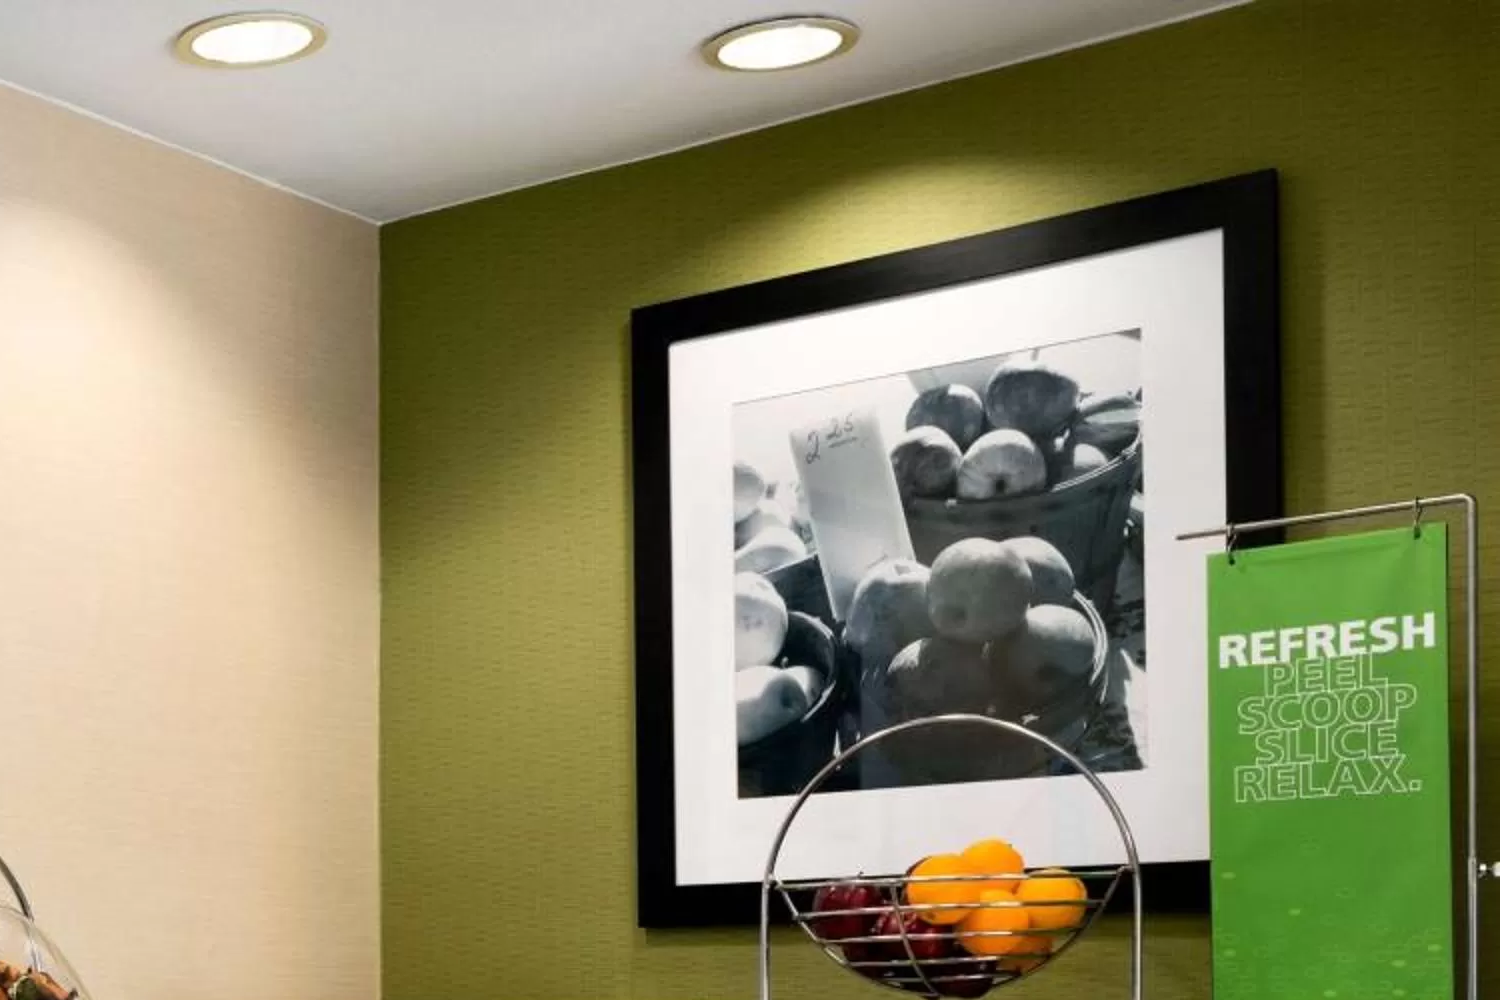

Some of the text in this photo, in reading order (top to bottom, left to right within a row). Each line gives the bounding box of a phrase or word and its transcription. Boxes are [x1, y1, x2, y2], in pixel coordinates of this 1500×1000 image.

[1219, 612, 1436, 669] REFRESH
[1265, 652, 1388, 698] PEEL
[1237, 683, 1418, 735] SCOOP
[1255, 720, 1399, 767] SLICE
[1234, 753, 1423, 803] RELAX.
